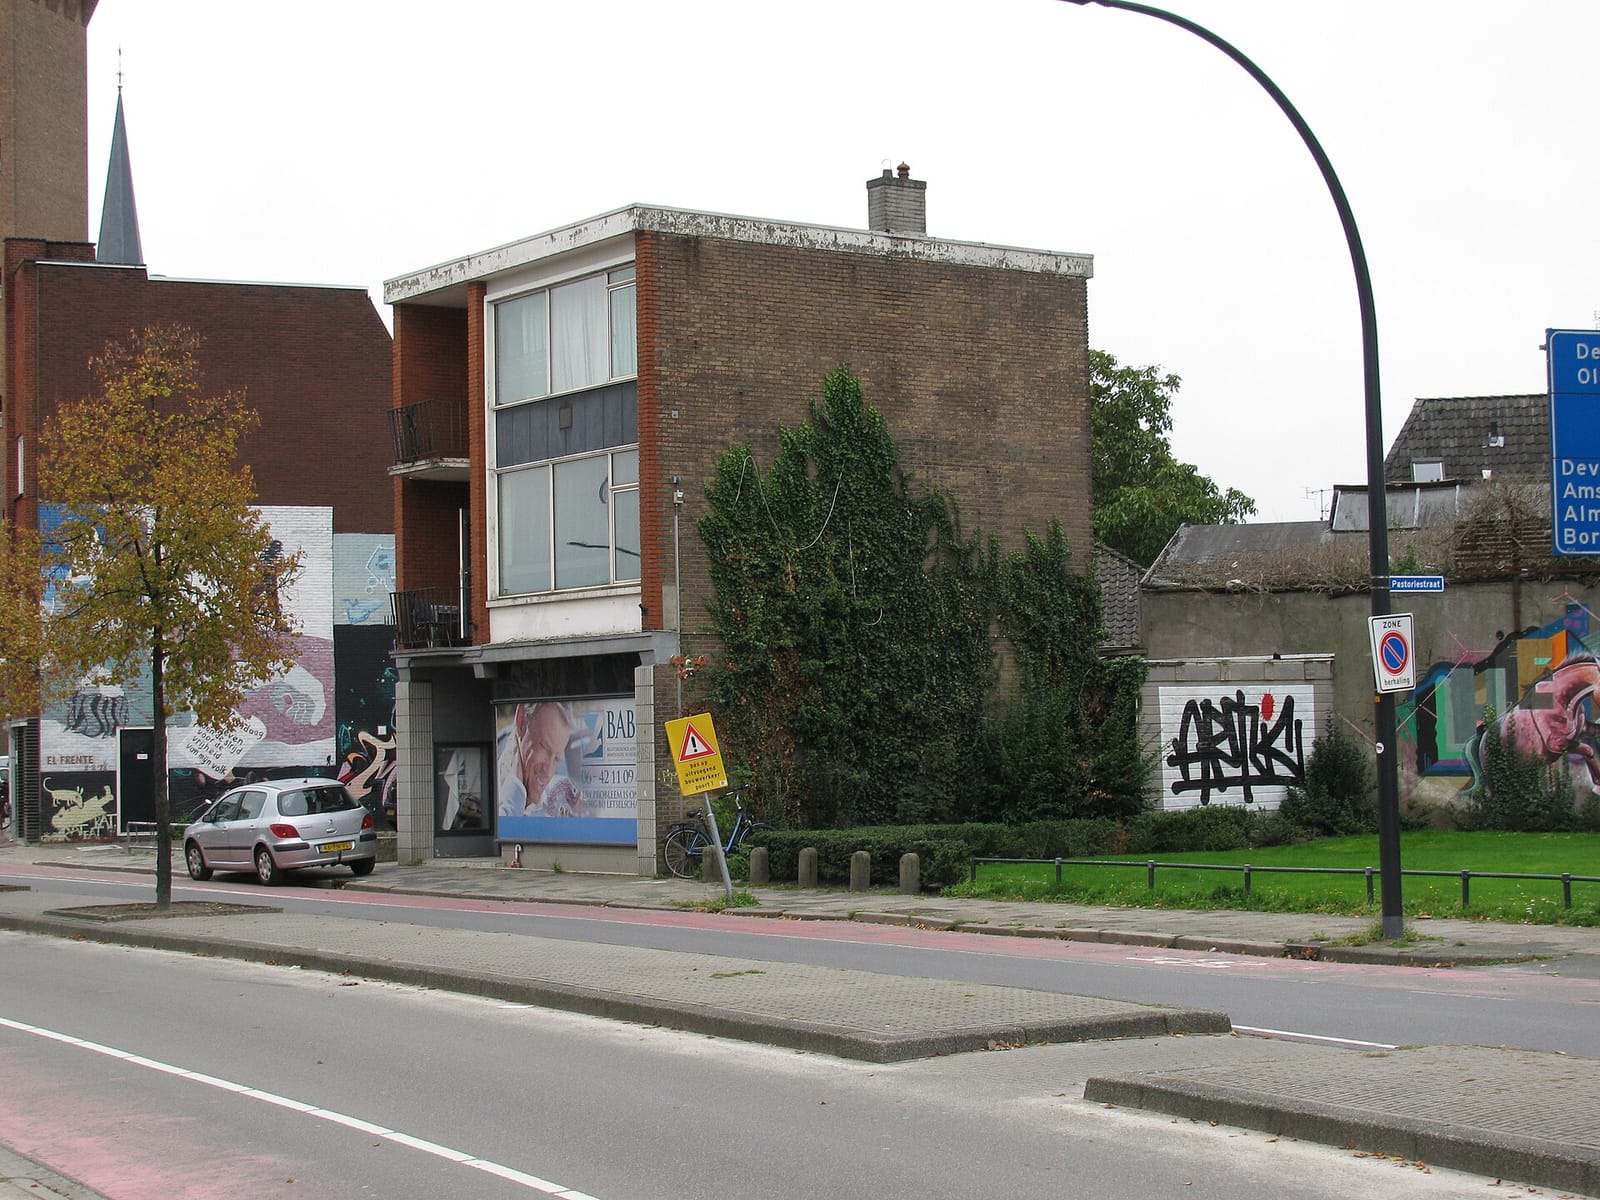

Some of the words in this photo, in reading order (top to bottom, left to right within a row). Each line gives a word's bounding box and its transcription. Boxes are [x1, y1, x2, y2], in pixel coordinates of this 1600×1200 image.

[1562, 459, 1600, 476] Dev
[1563, 504, 1600, 522] Alm
[1563, 527, 1600, 545] Bor
[1391, 579, 1441, 589] Pastoriestraat
[1383, 620, 1401, 629] ZONE
[1384, 677, 1410, 687] herhaling
[606, 709, 636, 739] BAB
[192, 735, 223, 760] vrijheid
[197, 728, 215, 743] voor
[214, 742, 224, 752] de
[47, 755, 58, 765] EL
[60, 755, 94, 765] FRENTE
[186, 743, 199, 756] van
[211, 763, 228, 775] volk
